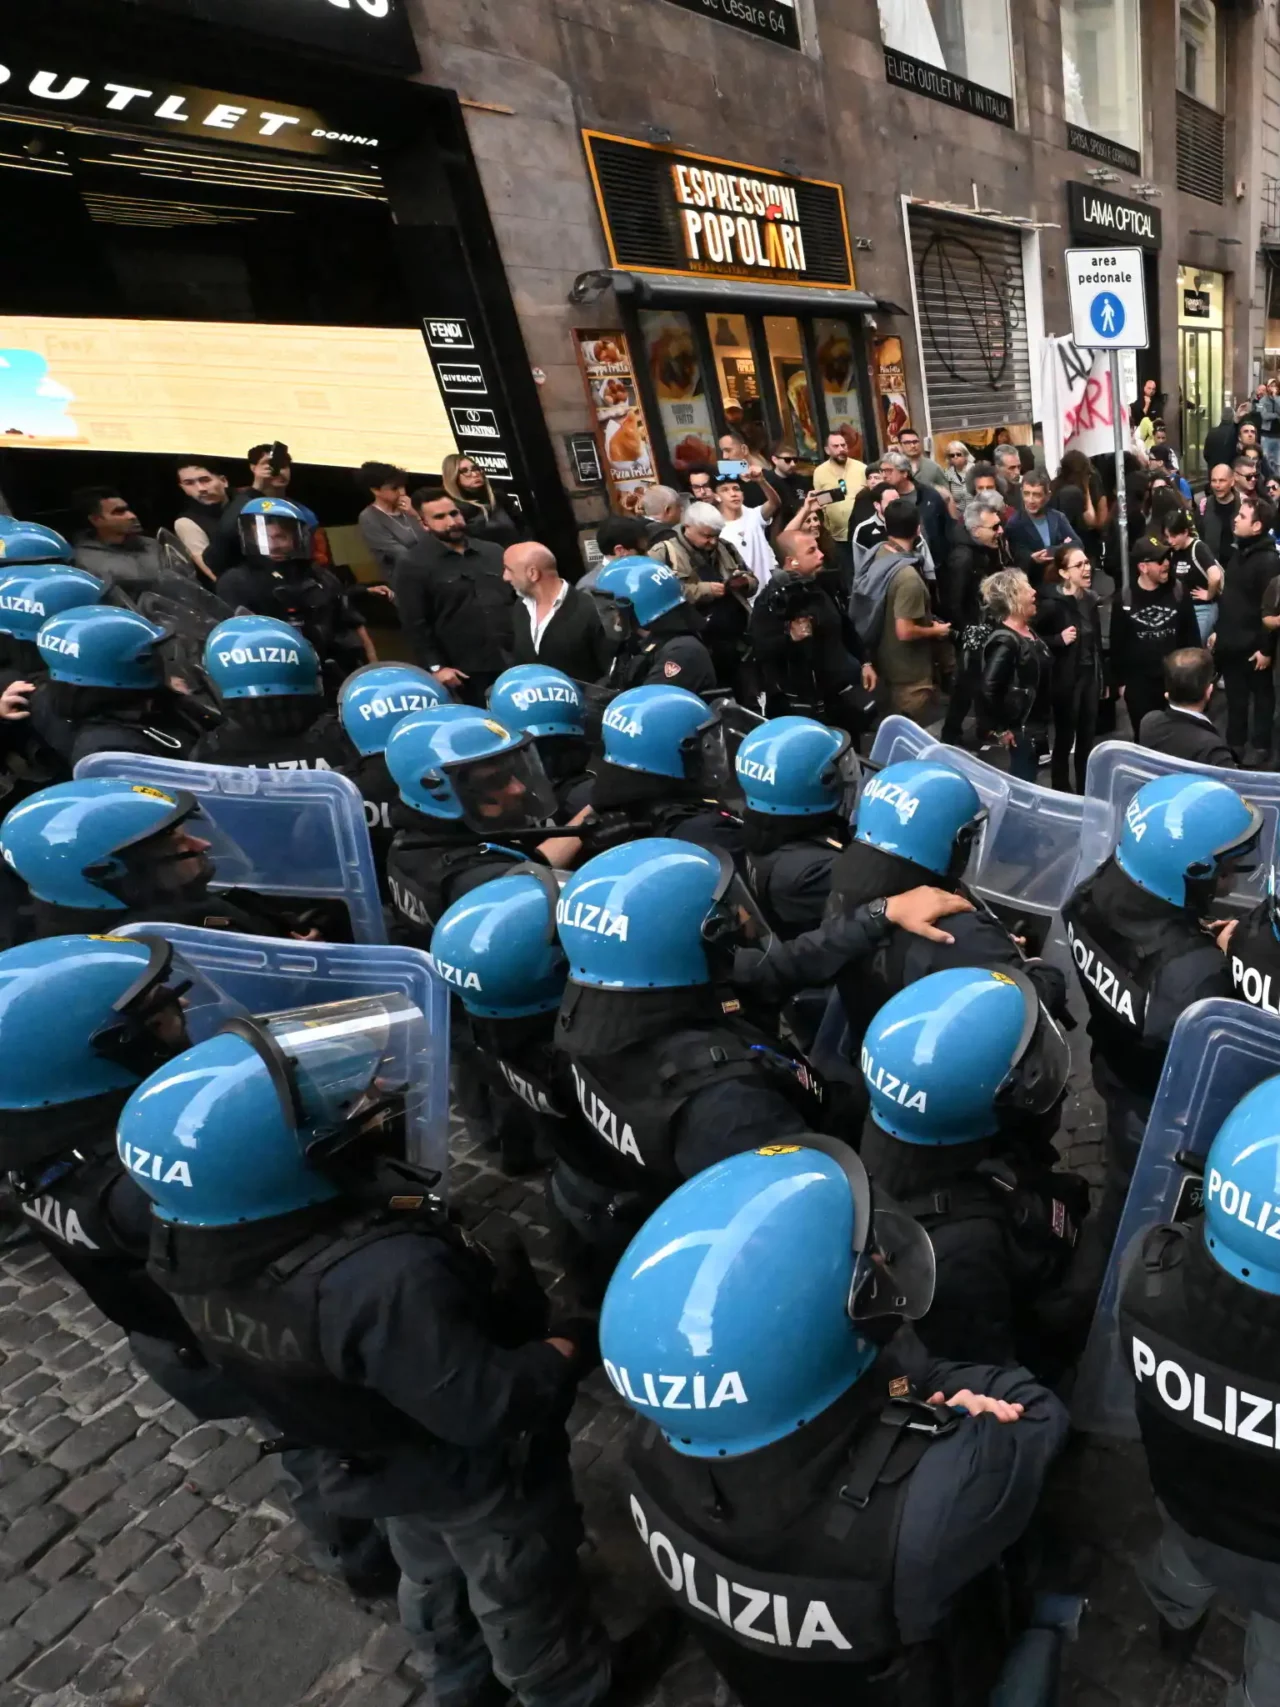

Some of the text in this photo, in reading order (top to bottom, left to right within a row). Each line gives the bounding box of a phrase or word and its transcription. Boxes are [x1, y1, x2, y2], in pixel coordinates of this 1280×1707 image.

[769, 10, 786, 35] 64
[917, 67, 951, 97] OUTLET
[975, 92, 984, 112] IN
[985, 95, 1008, 119] ITALIA
[311, 129, 379, 147] DONNA
[671, 164, 800, 222] ESPRESSIONI
[1082, 196, 1155, 239] LAMA OPTICAL
[681, 209, 807, 271] POPOLARI
[1091, 256, 1117, 266] area
[1078, 271, 1132, 285] pedonale
[430, 322, 463, 339] FENDI
[443, 374, 482, 383] GIVENCHY
[459, 424, 496, 436] VALENTINO
[218, 647, 300, 668] POLIZIA
[358, 695, 440, 721] POLIZIA
[511, 688, 579, 709] POLIZIA
[1067, 921, 1137, 1025] POLIZIA
[630, 1493, 853, 1650] POLIZIA
